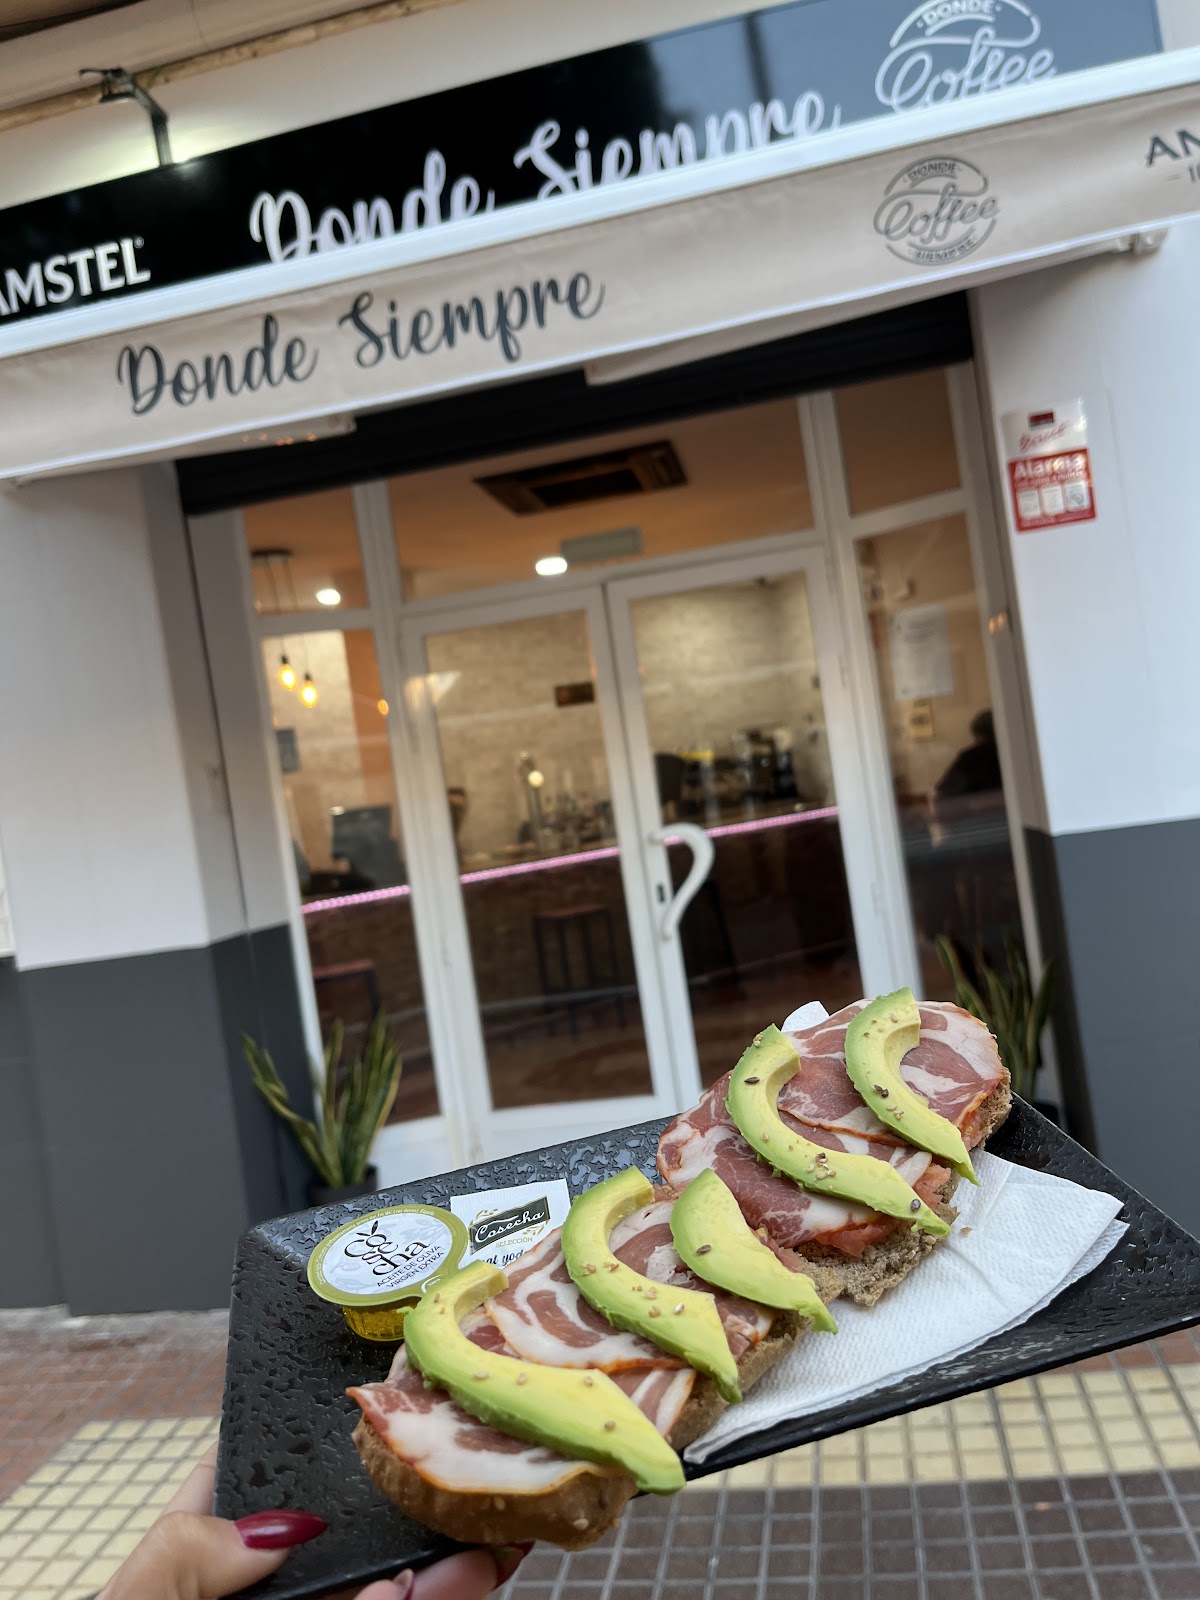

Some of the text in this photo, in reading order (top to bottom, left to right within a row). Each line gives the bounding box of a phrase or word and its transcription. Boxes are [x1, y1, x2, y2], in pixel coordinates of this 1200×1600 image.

[922, 0, 994, 25] DONDE
[874, 26, 1057, 113] Coffee
[249, 149, 496, 263] Donde
[873, 183, 1000, 244] Coffee
[116, 271, 606, 415] Donde Siempre
[475, 1210, 545, 1243] Cosecha
[495, 1236, 533, 1249] SELECCIÓN
[377, 1245, 442, 1287] ACEITE DE OLIVA
[386, 1251, 446, 1289] VIRGEN EXTRA
